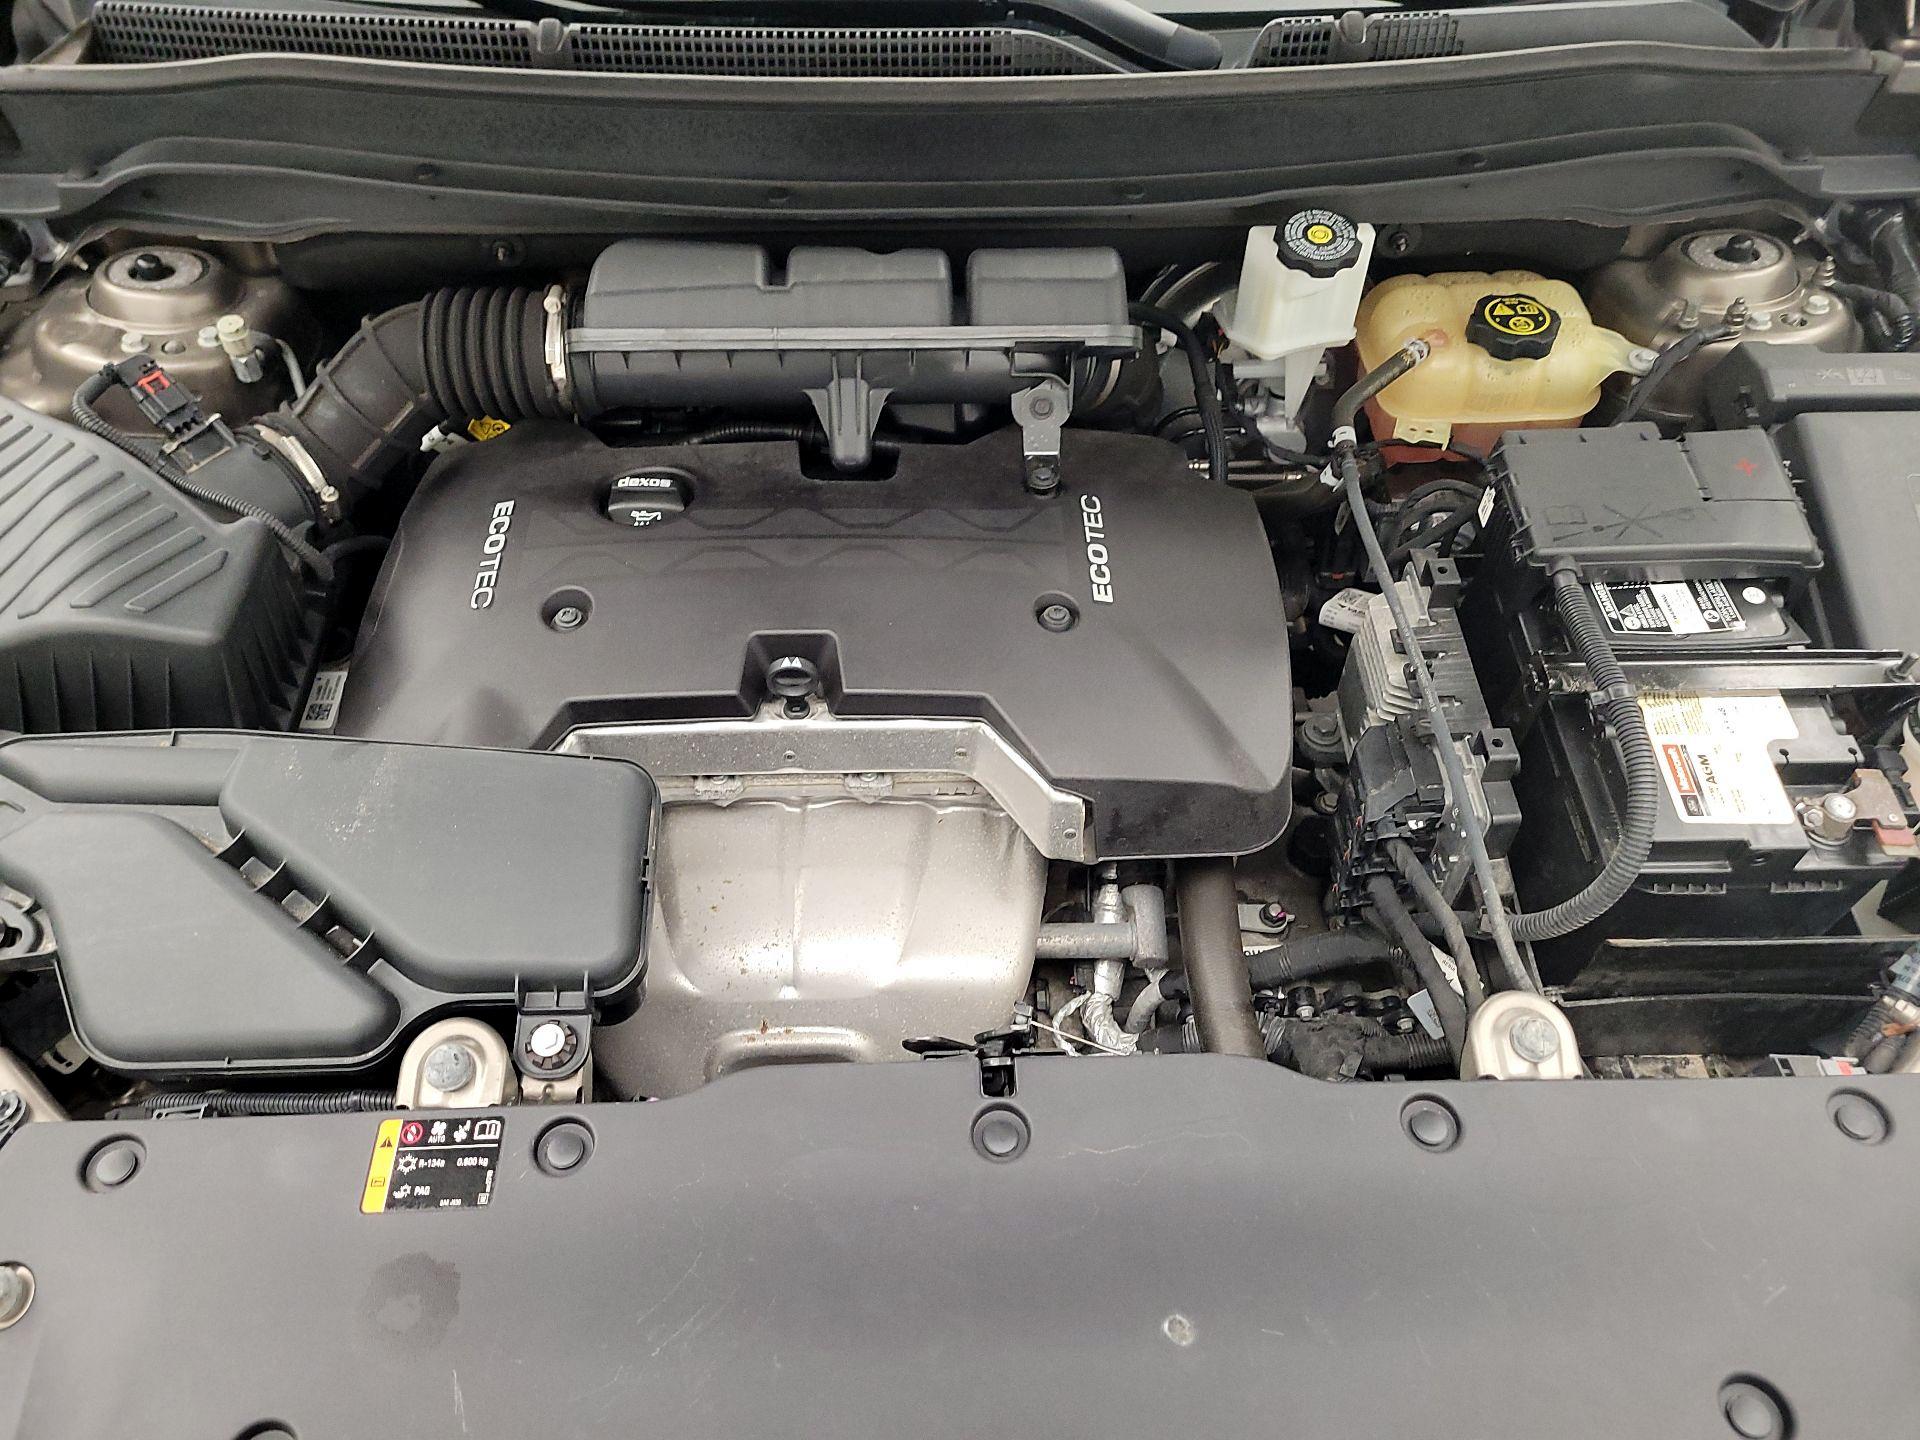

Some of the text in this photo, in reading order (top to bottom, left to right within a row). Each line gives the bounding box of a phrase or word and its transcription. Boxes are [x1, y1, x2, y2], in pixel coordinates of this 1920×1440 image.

[618, 476, 671, 488] dexos
[470, 500, 515, 609] ECOTEC
[1080, 494, 1114, 603] ECOTEC
[1697, 754, 1718, 785] AGM
[428, 1134, 446, 1143] AUTO
[414, 1186, 431, 1196] PAG
